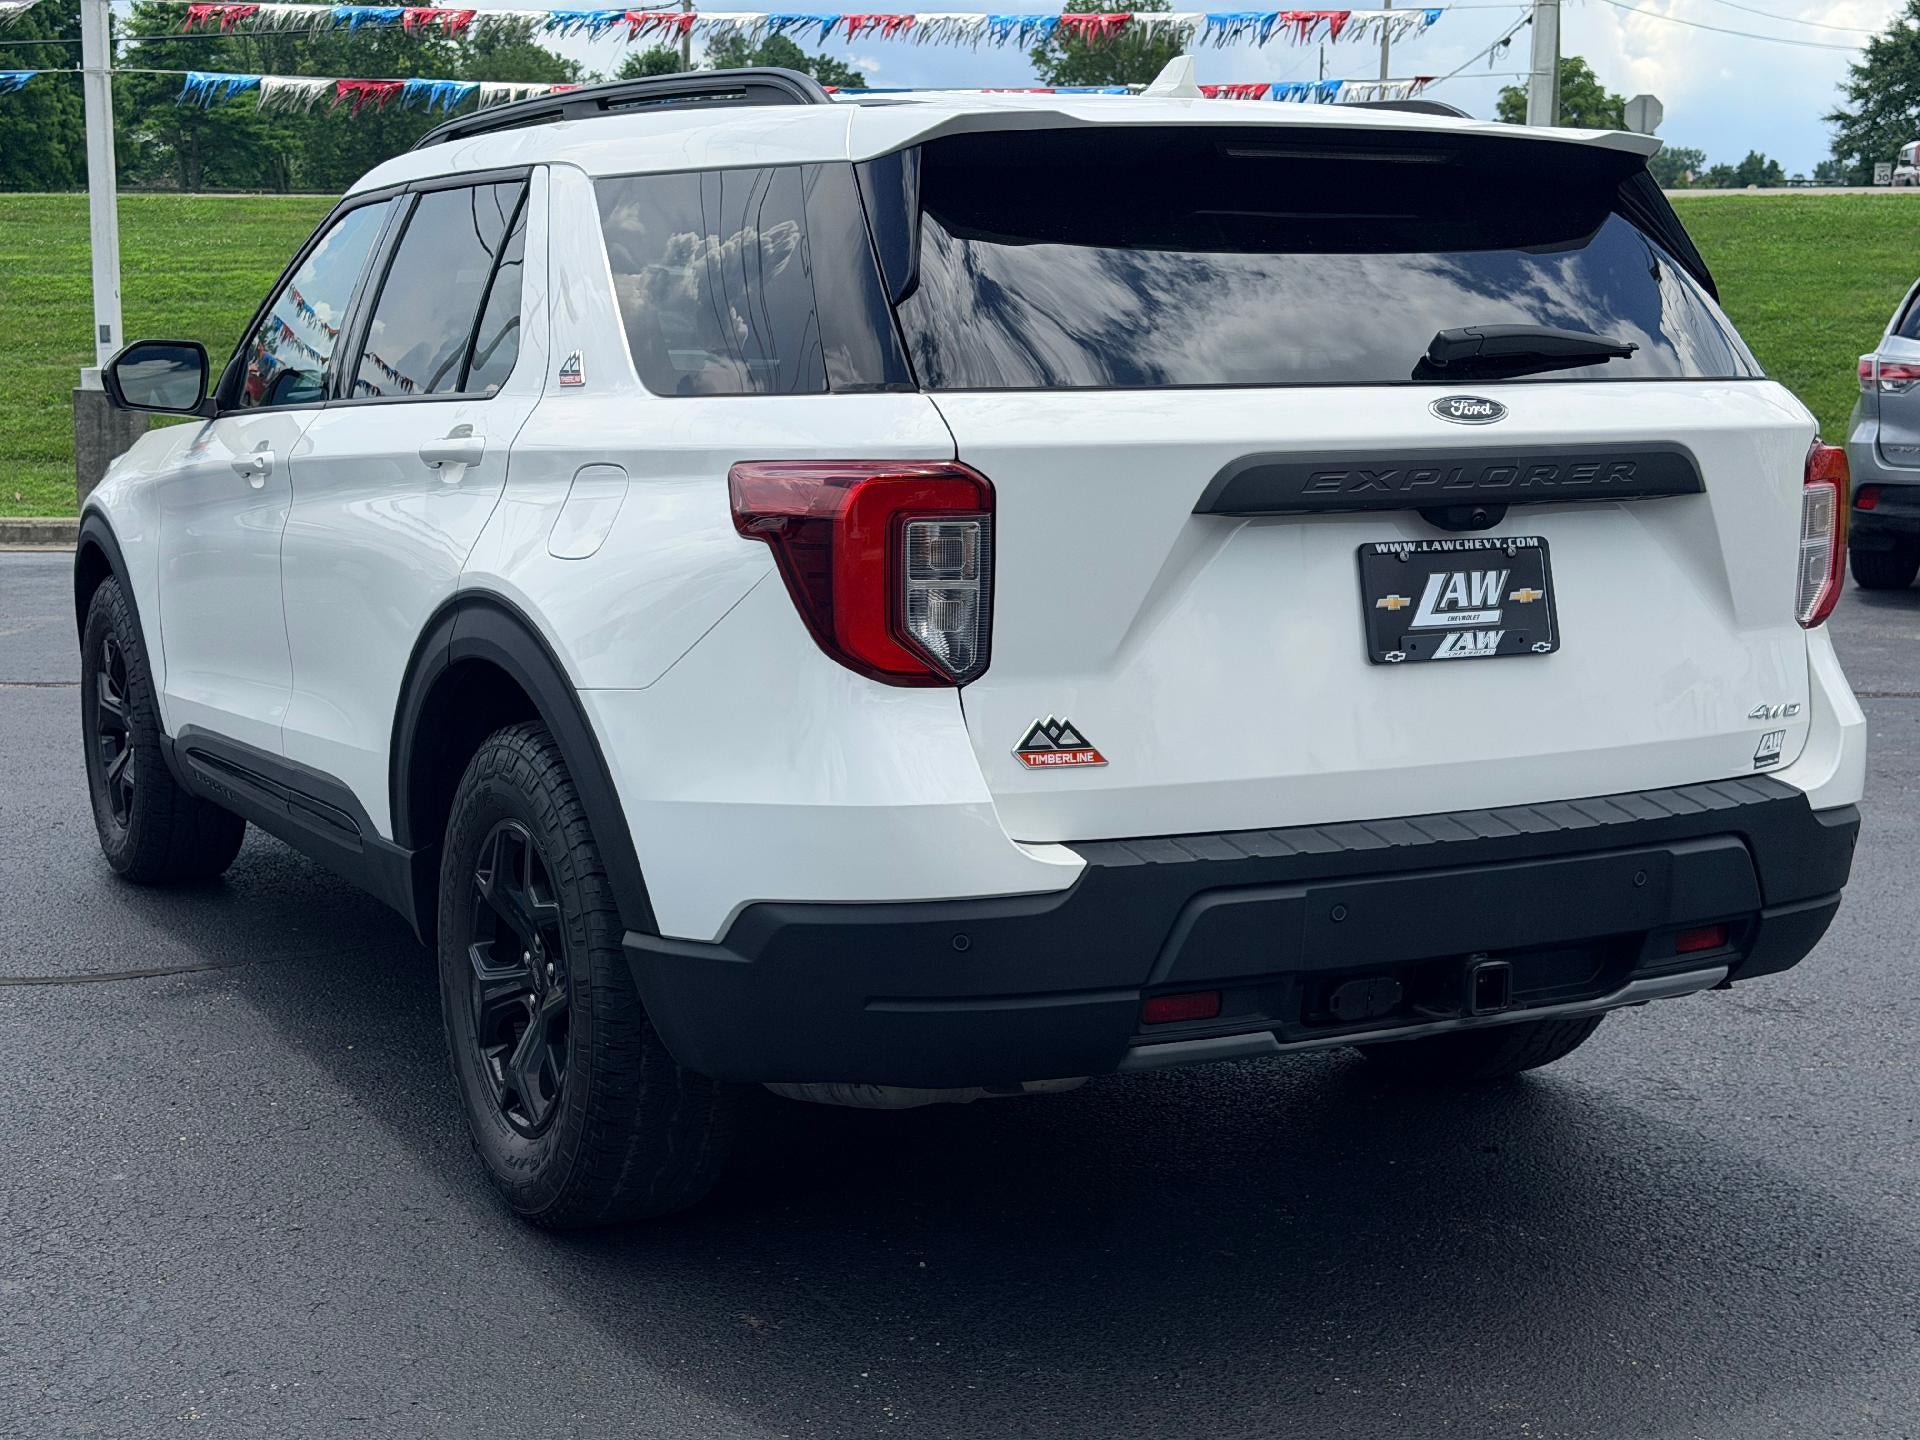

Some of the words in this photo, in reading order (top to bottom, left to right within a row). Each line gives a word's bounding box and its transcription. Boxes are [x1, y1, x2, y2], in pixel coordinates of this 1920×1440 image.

[1451, 399, 1493, 416] Ford
[1301, 461, 1637, 494] EXPLORER
[1375, 537, 1539, 554] WWW.LAWCHEVY.COM
[1409, 569, 1510, 630] LAW
[1447, 613, 1481, 622] CHEVROLET
[1431, 629, 1506, 659] LAW
[1747, 703, 1801, 720] 4WD
[1027, 751, 1095, 765] TIMBERLINE
